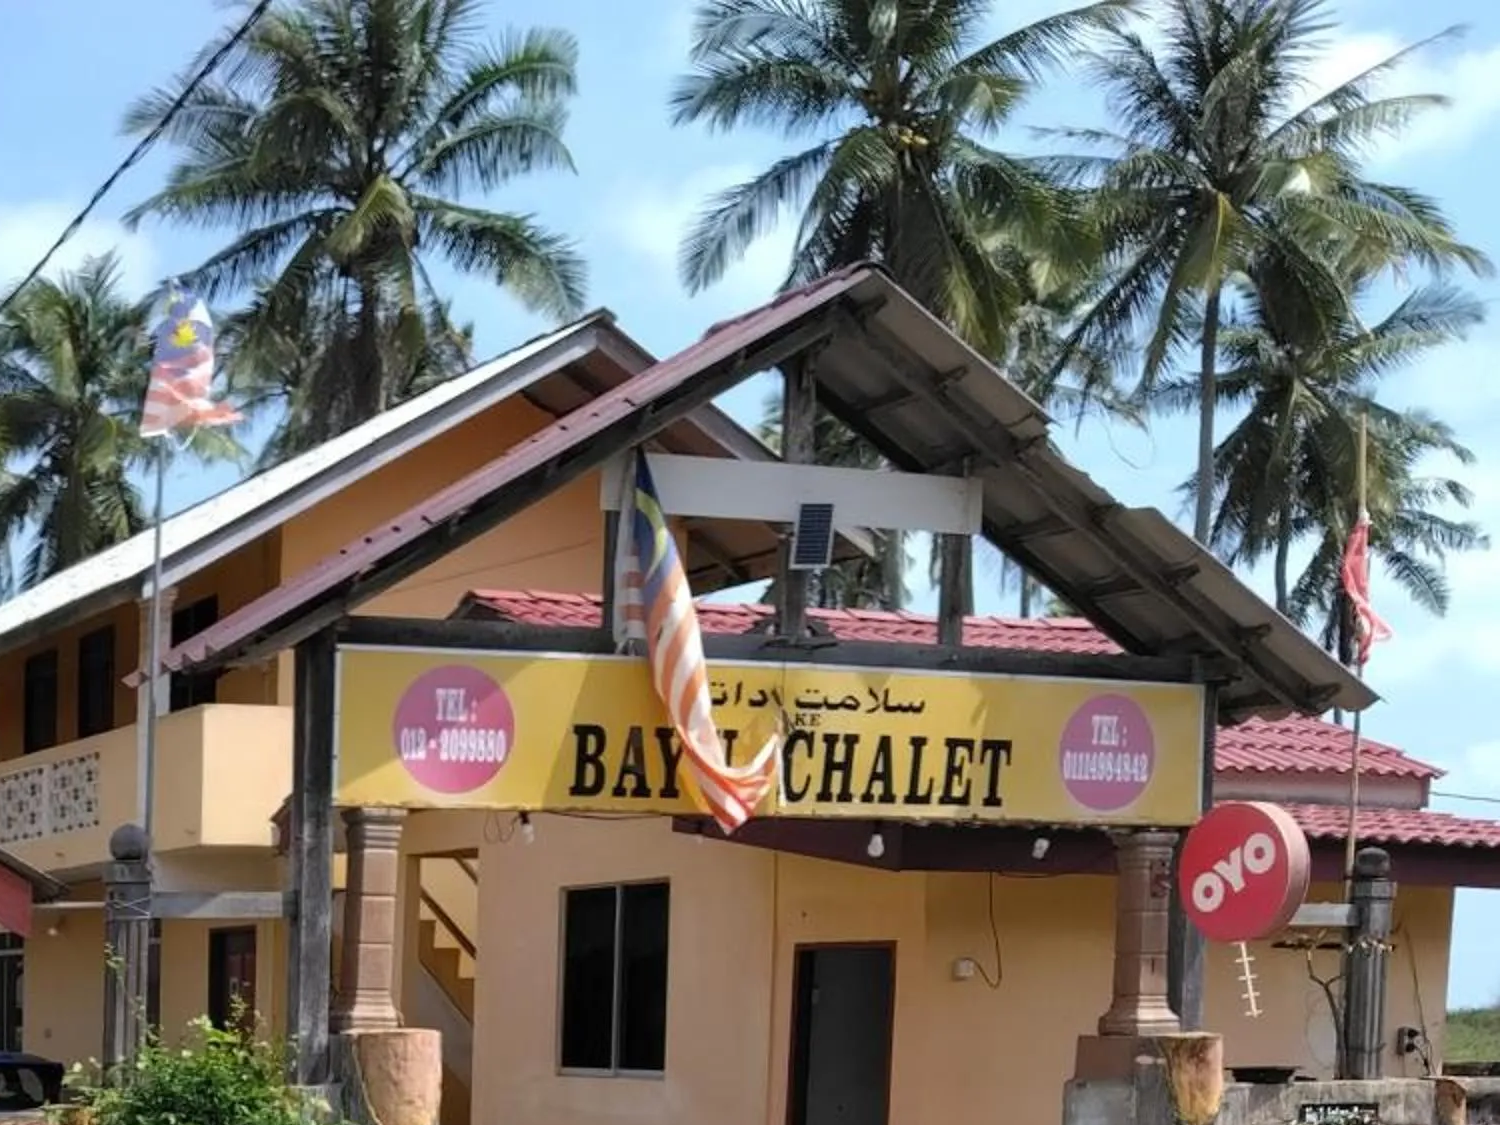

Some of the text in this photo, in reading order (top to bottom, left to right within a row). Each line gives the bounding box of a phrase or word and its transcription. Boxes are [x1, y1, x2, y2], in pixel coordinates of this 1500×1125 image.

[711, 681, 769, 708] دات
[783, 729, 1012, 807] CHALET
[1192, 832, 1276, 913] OYO
